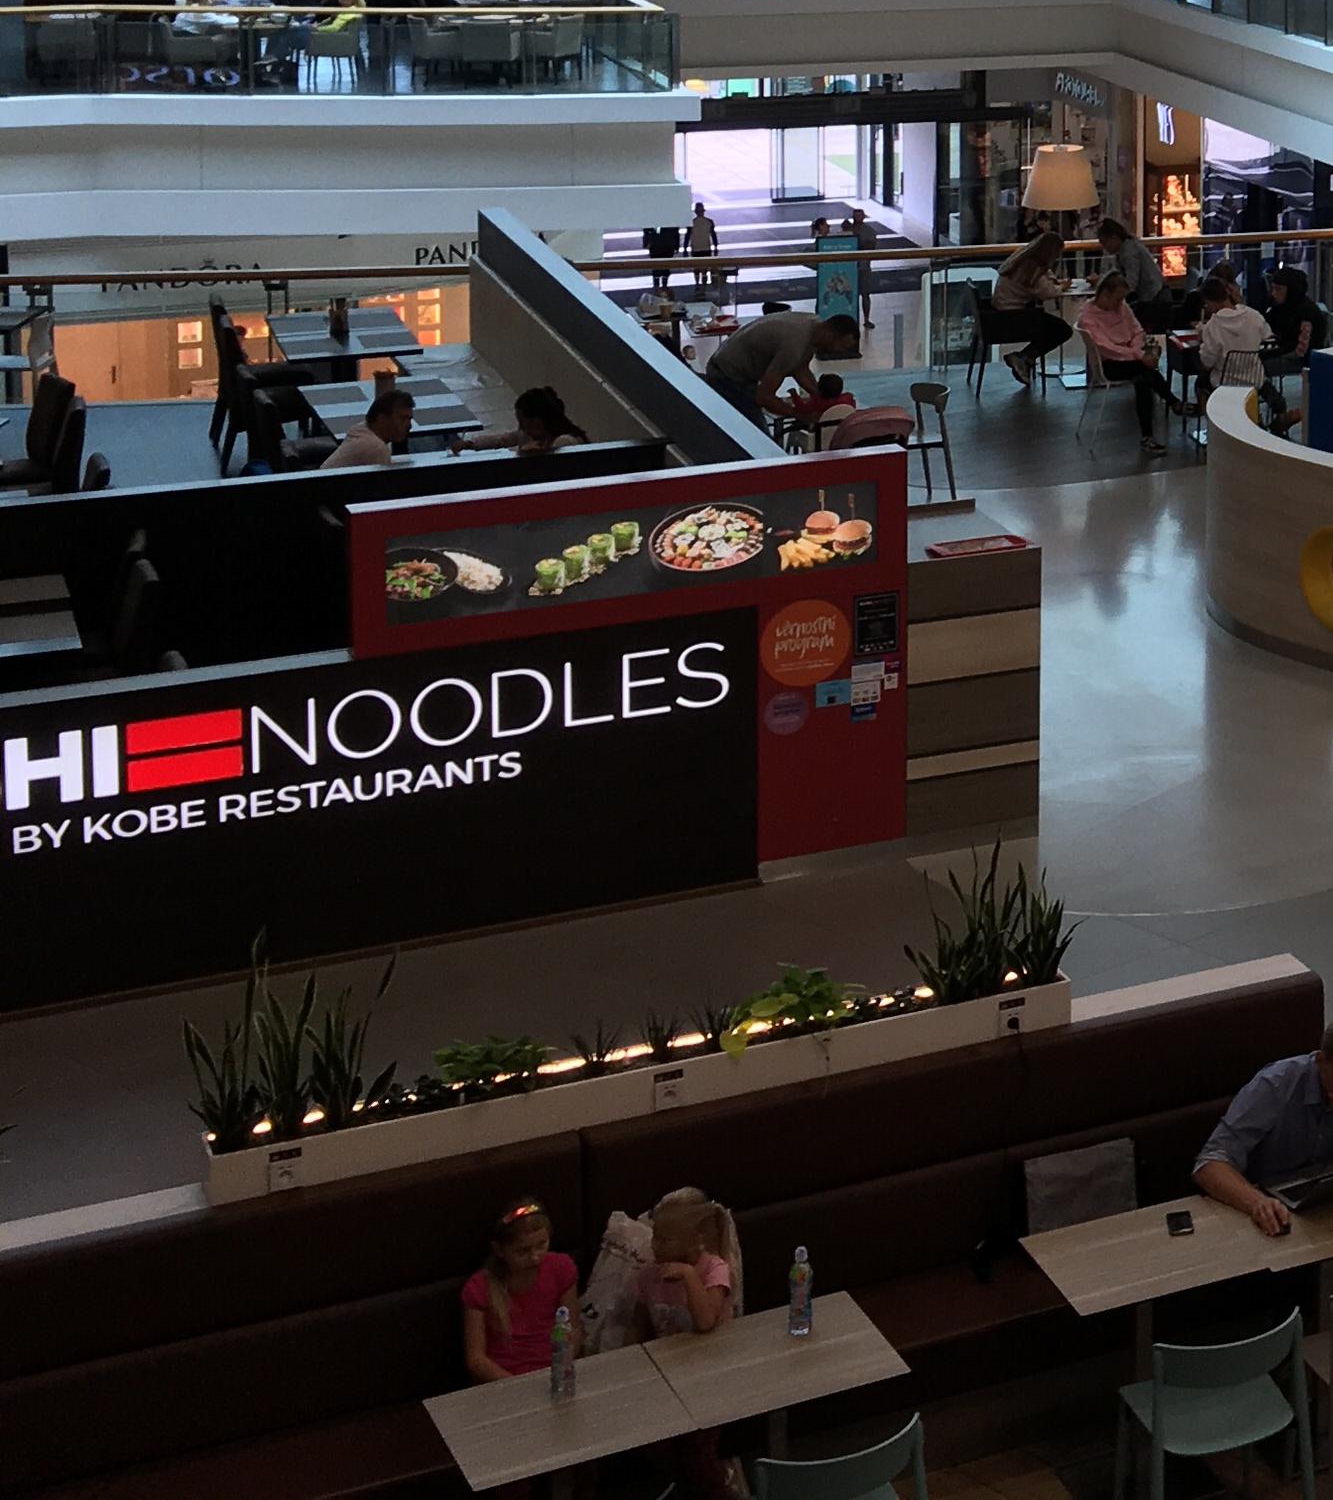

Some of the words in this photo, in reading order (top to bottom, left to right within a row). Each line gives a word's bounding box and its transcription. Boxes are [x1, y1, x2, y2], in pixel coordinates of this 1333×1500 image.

[4, 724, 120, 811] HI
[251, 642, 731, 774] NOODLES
[12, 819, 71, 854] BY
[83, 799, 207, 844] KOBE
[218, 751, 522, 823] RESTAURANTS
